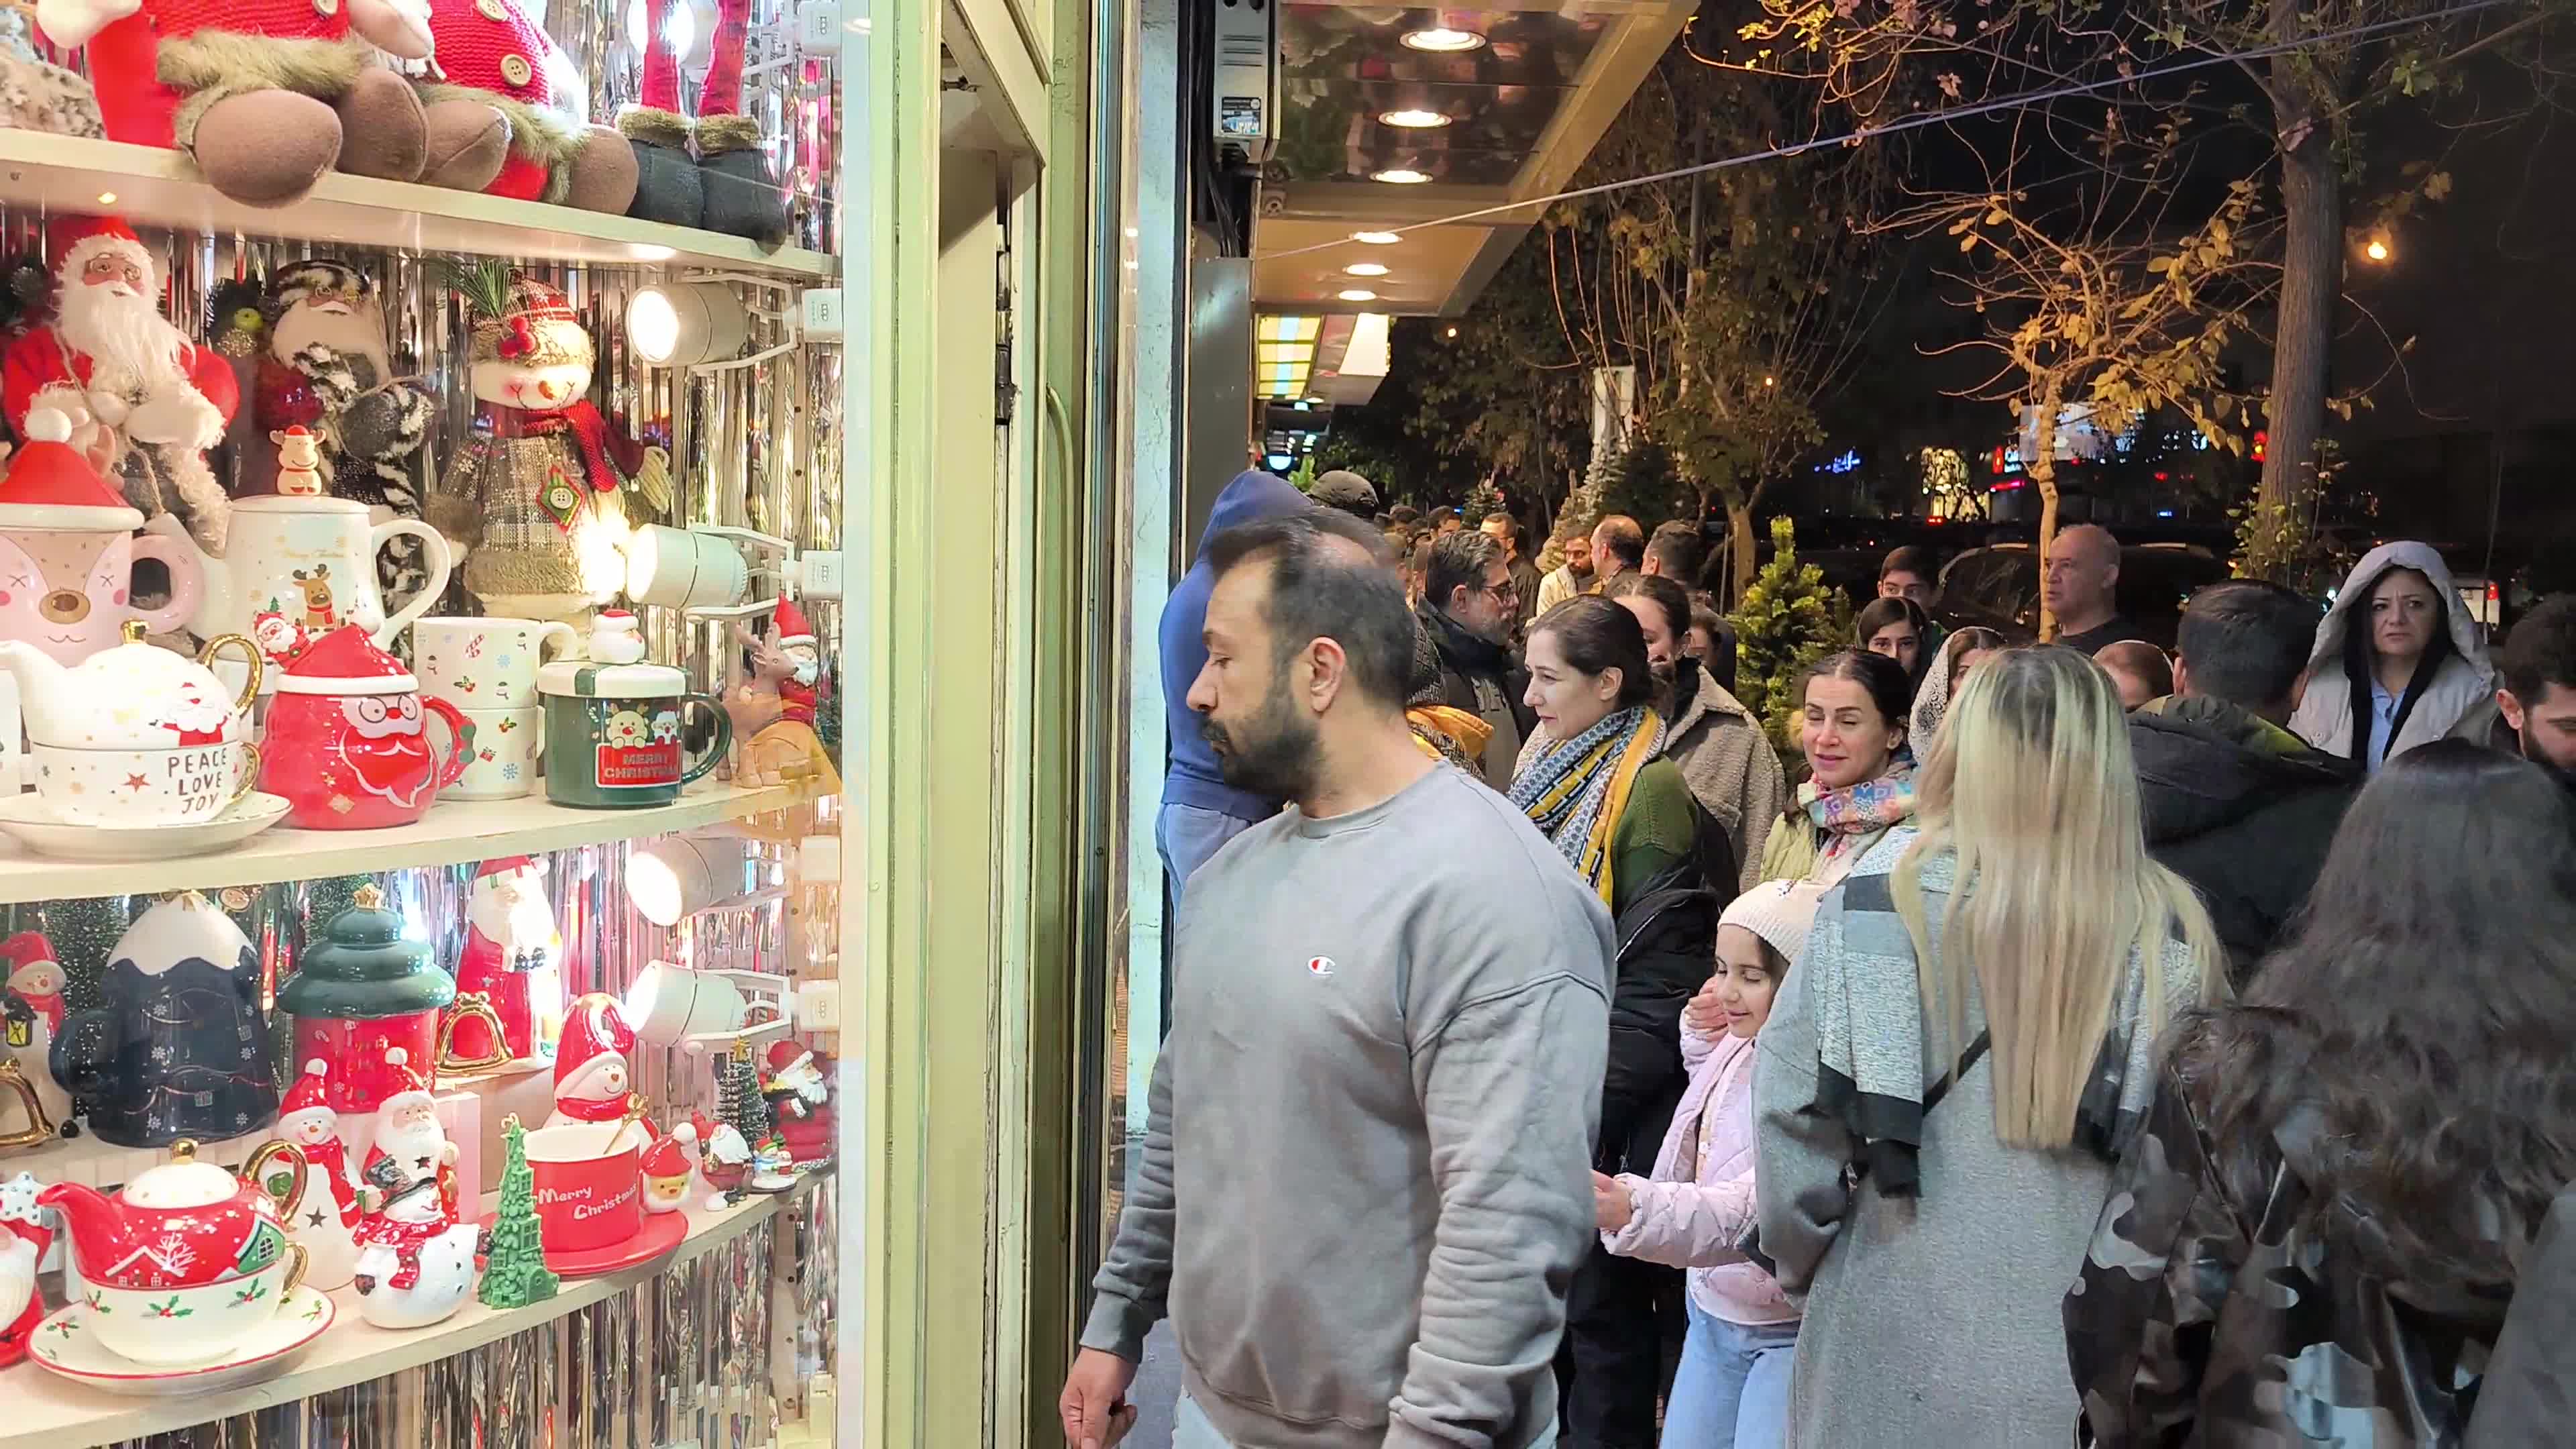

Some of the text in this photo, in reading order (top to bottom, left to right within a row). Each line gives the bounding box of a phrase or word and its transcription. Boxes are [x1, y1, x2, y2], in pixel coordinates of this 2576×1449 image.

[168, 747, 227, 777] PEACE
[178, 771, 222, 796] LOVE
[182, 792, 219, 814] JOY
[538, 1186, 592, 1205] Merry
[574, 1183, 637, 1220] Christmas
